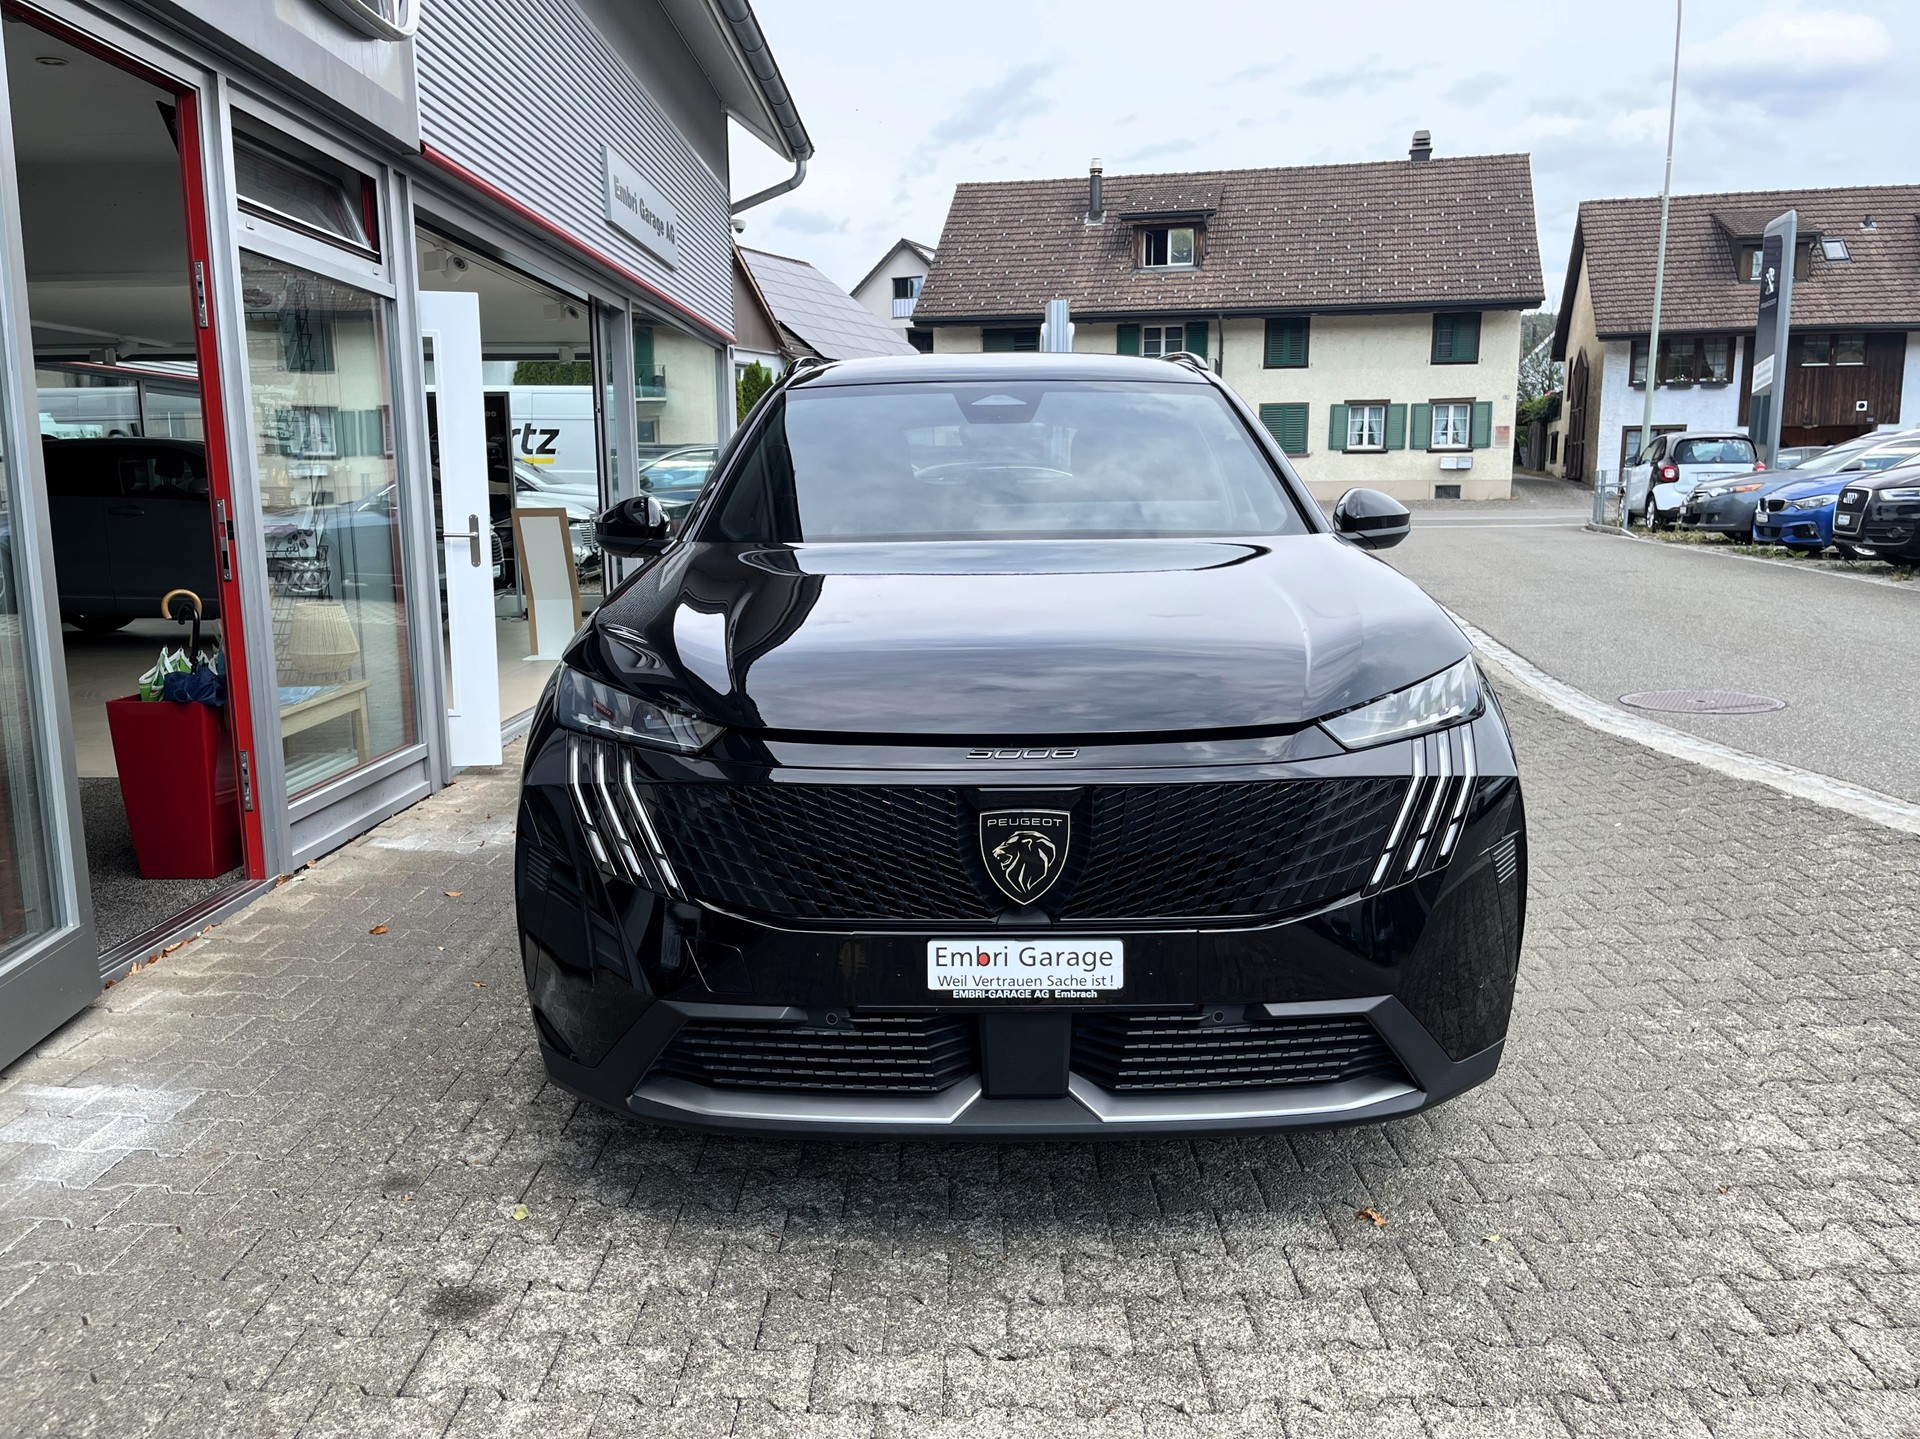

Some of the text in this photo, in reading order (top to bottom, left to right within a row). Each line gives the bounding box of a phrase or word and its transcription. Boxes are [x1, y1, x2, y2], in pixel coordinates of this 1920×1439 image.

[614, 175, 675, 245] Embri Garage AG
[966, 749, 1080, 759] 5008
[987, 818, 1062, 827] PEUGEOT
[936, 946, 1113, 972] Embri Garage
[937, 975, 967, 987] Weil
[972, 975, 1042, 987] Vertrauen
[1047, 974, 1087, 987] Sache
[953, 989, 1097, 999] EMBRI-GARAGE AG Embrach
